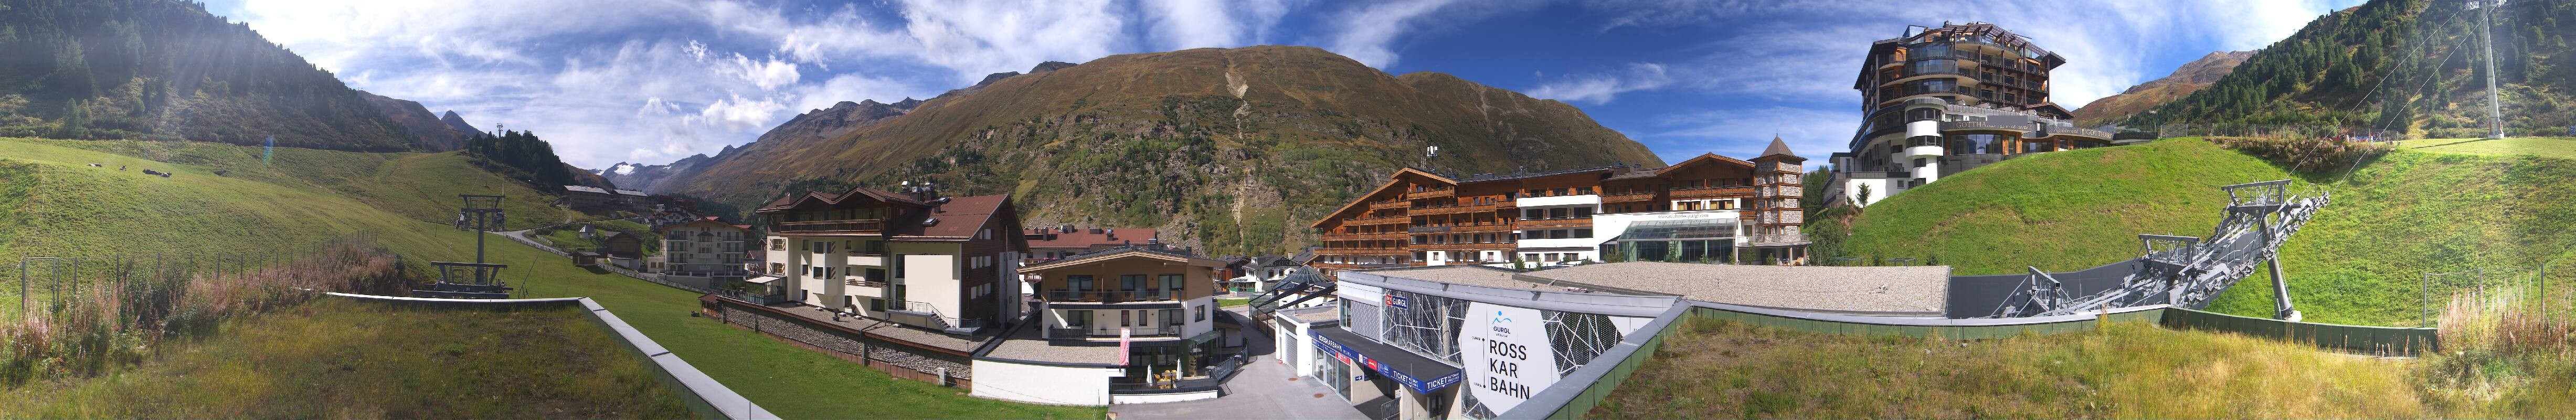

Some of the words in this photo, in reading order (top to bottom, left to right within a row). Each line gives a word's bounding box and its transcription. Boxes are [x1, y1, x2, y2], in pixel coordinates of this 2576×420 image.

[1393, 298, 1407, 307] GURGL
[1319, 334, 1342, 352] ROSSKARBAHN
[1490, 339, 1526, 361] ROSS
[1393, 370, 1408, 383] TICKET
[1490, 358, 1518, 379] KAR
[1427, 376, 1448, 389] TICKET
[1490, 376, 1530, 401] BAHN
